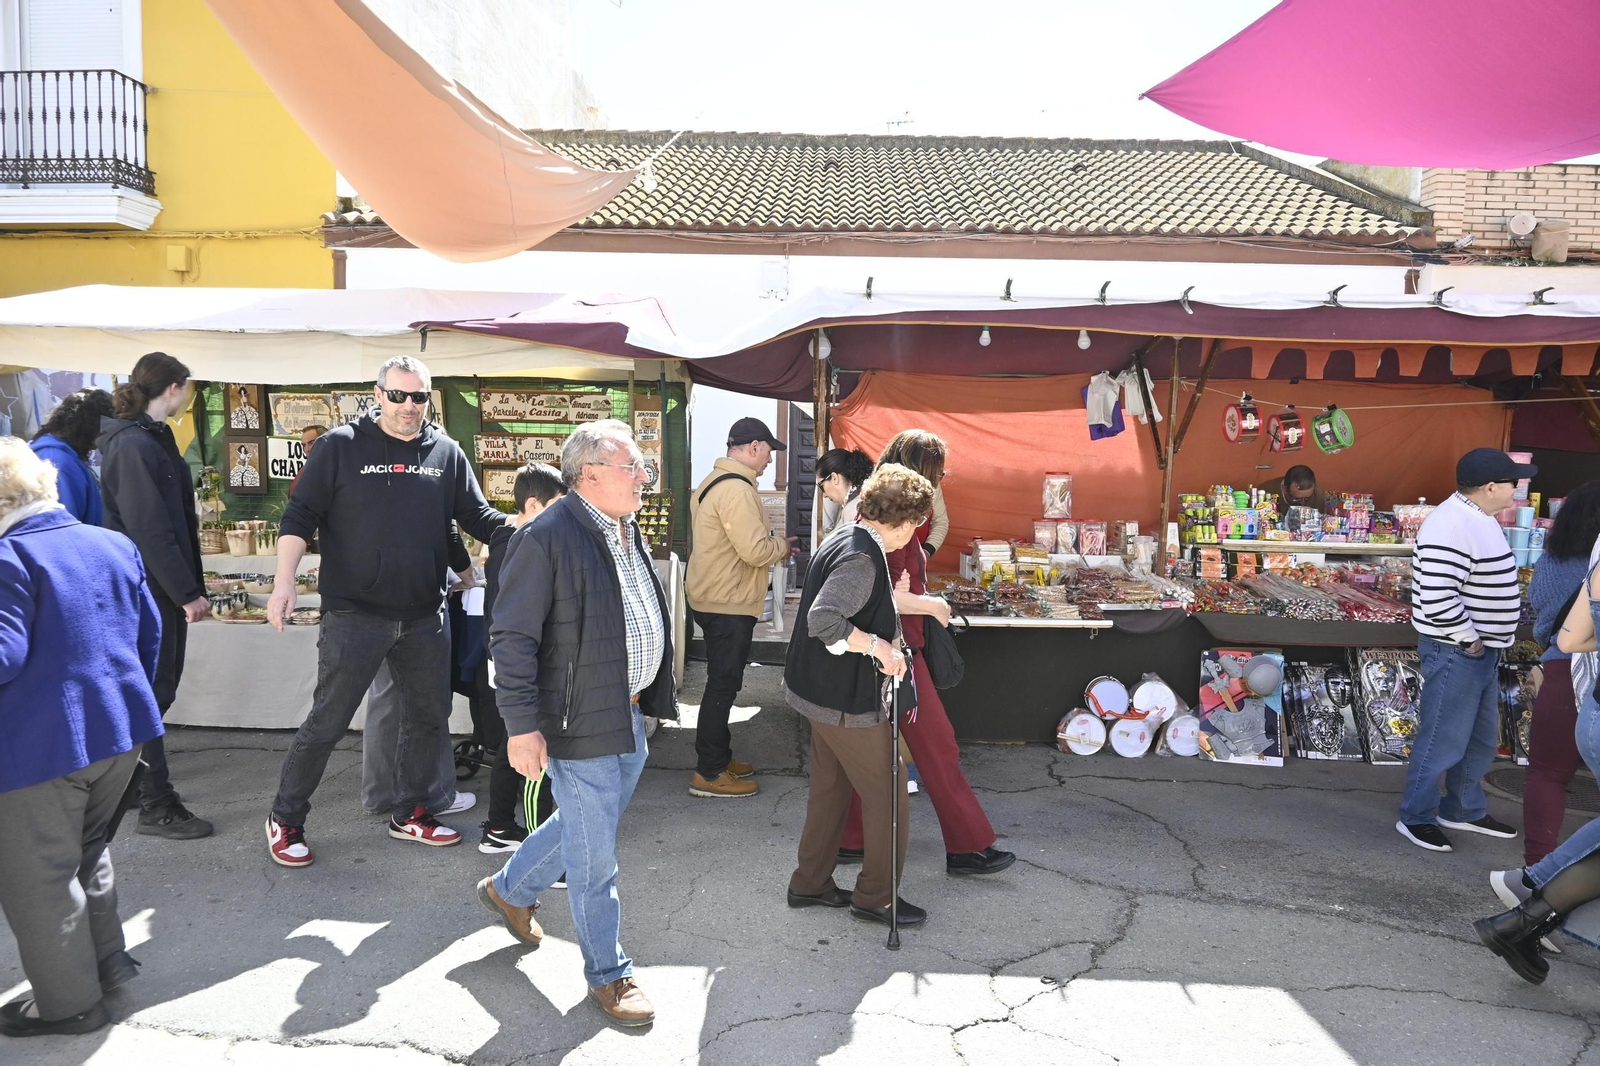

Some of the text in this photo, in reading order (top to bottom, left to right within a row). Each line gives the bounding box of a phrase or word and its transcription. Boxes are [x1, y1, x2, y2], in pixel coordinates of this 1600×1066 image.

[499, 394, 509, 404] La
[531, 398, 544, 406] La
[492, 406, 518, 416] Parcela
[528, 408, 562, 416] Casita
[576, 411, 599, 419] Adriana
[484, 440, 507, 448] VILLA
[534, 440, 544, 449] El
[524, 450, 555, 460] Caserón
[360, 464, 442, 476] JACK JONES
[506, 476, 514, 484] El
[1364, 651, 1419, 660] WEAPONS
